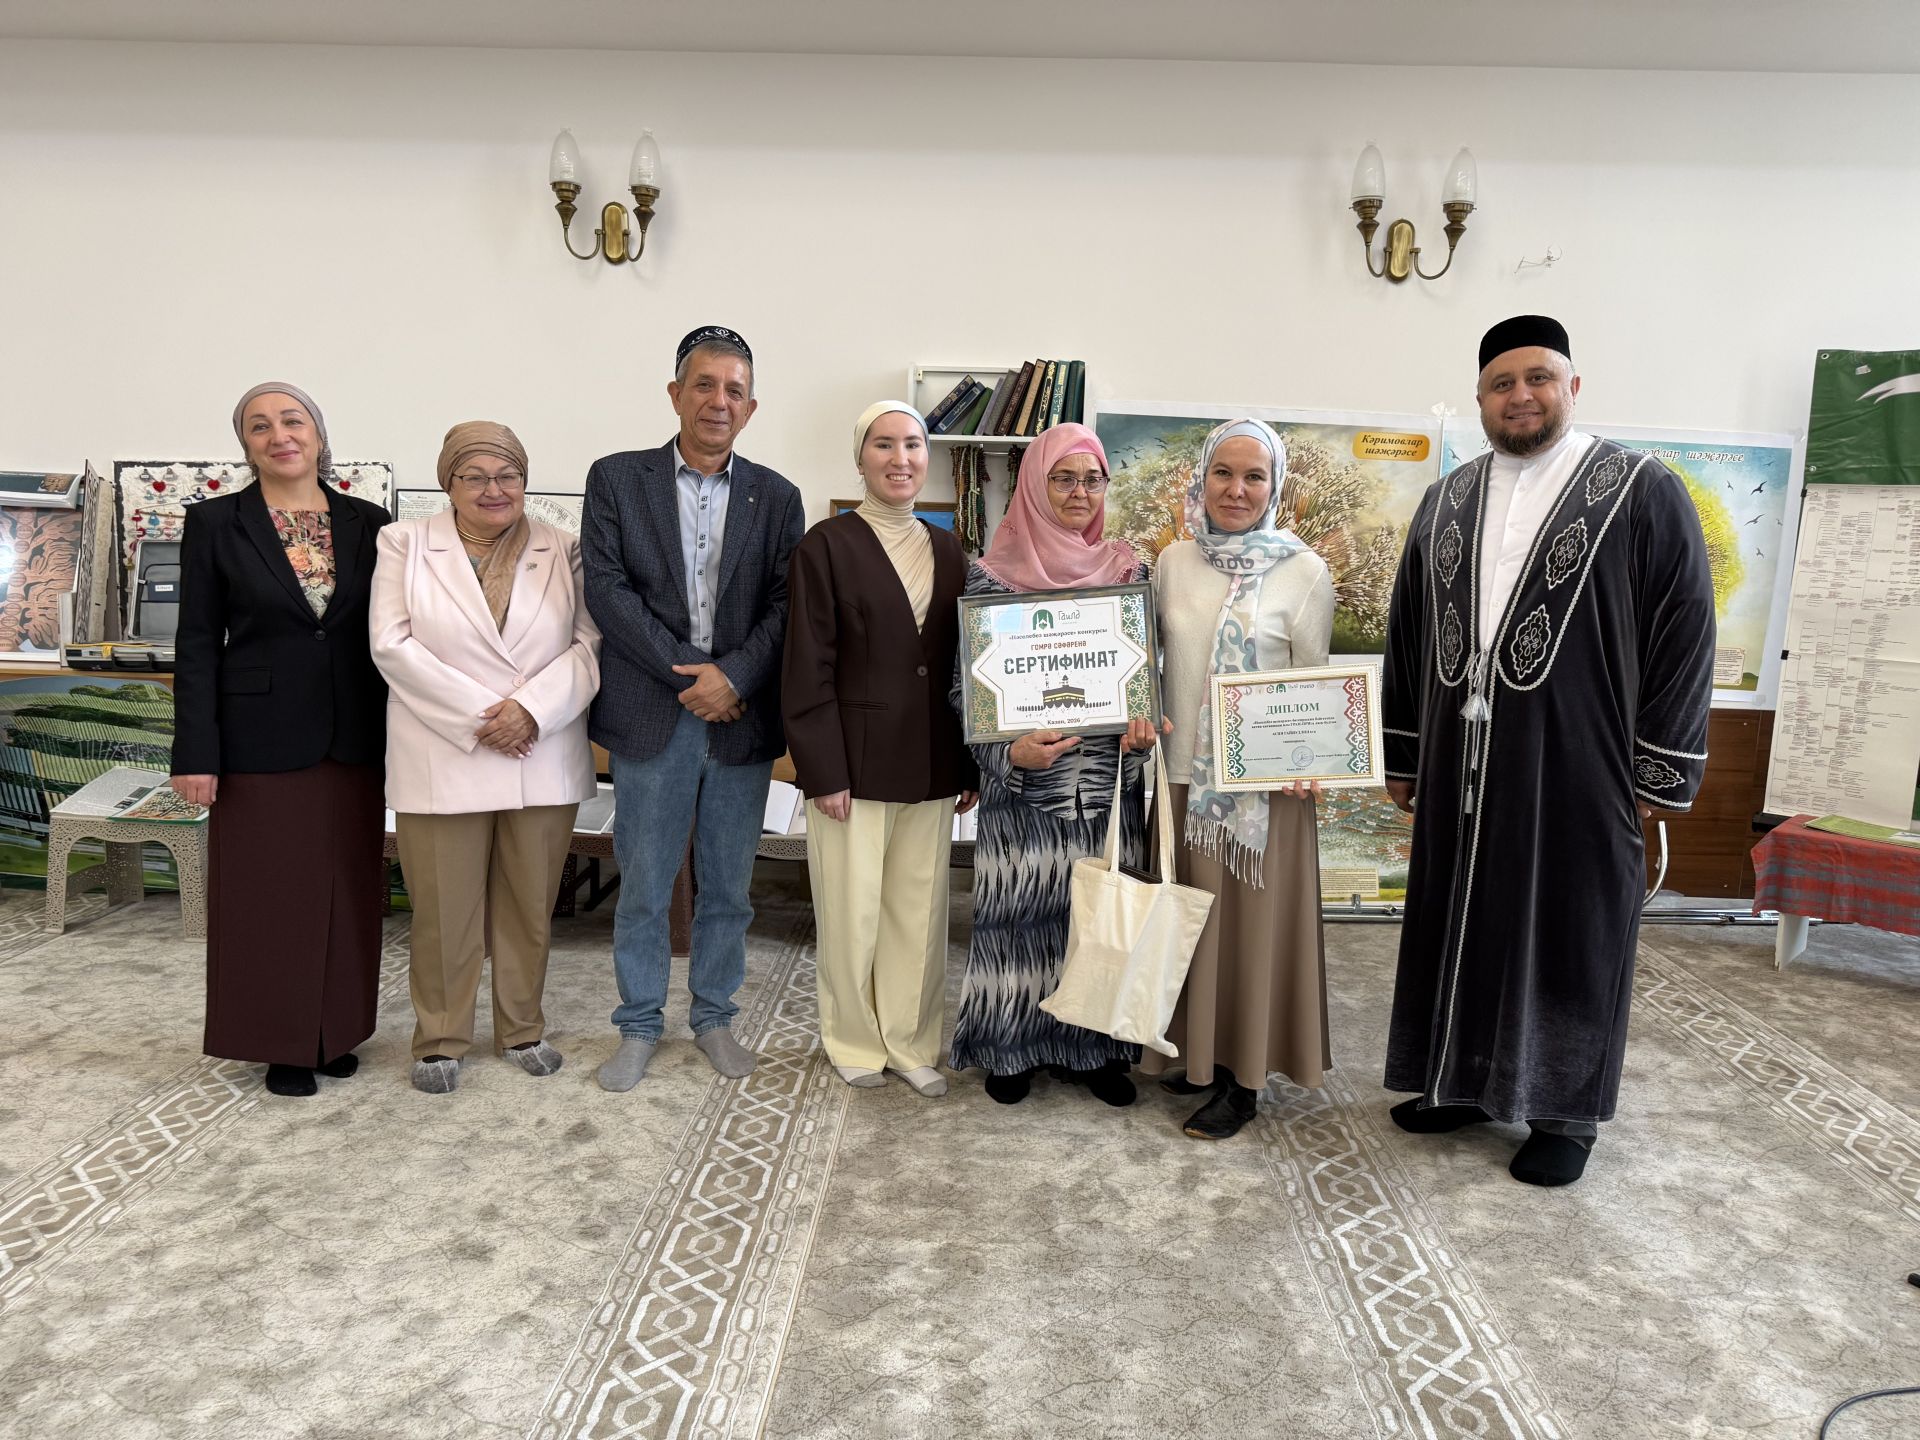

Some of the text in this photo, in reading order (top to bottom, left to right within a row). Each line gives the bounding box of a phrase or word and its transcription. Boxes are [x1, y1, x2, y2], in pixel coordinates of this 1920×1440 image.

[1361, 434, 1423, 448] Кәримовлар
[1365, 447, 1417, 457] шәҗәрәсе
[1004, 650, 1118, 675] СЕРТИФИКАТ
[1265, 703, 1320, 716] ДИПЛОМ
